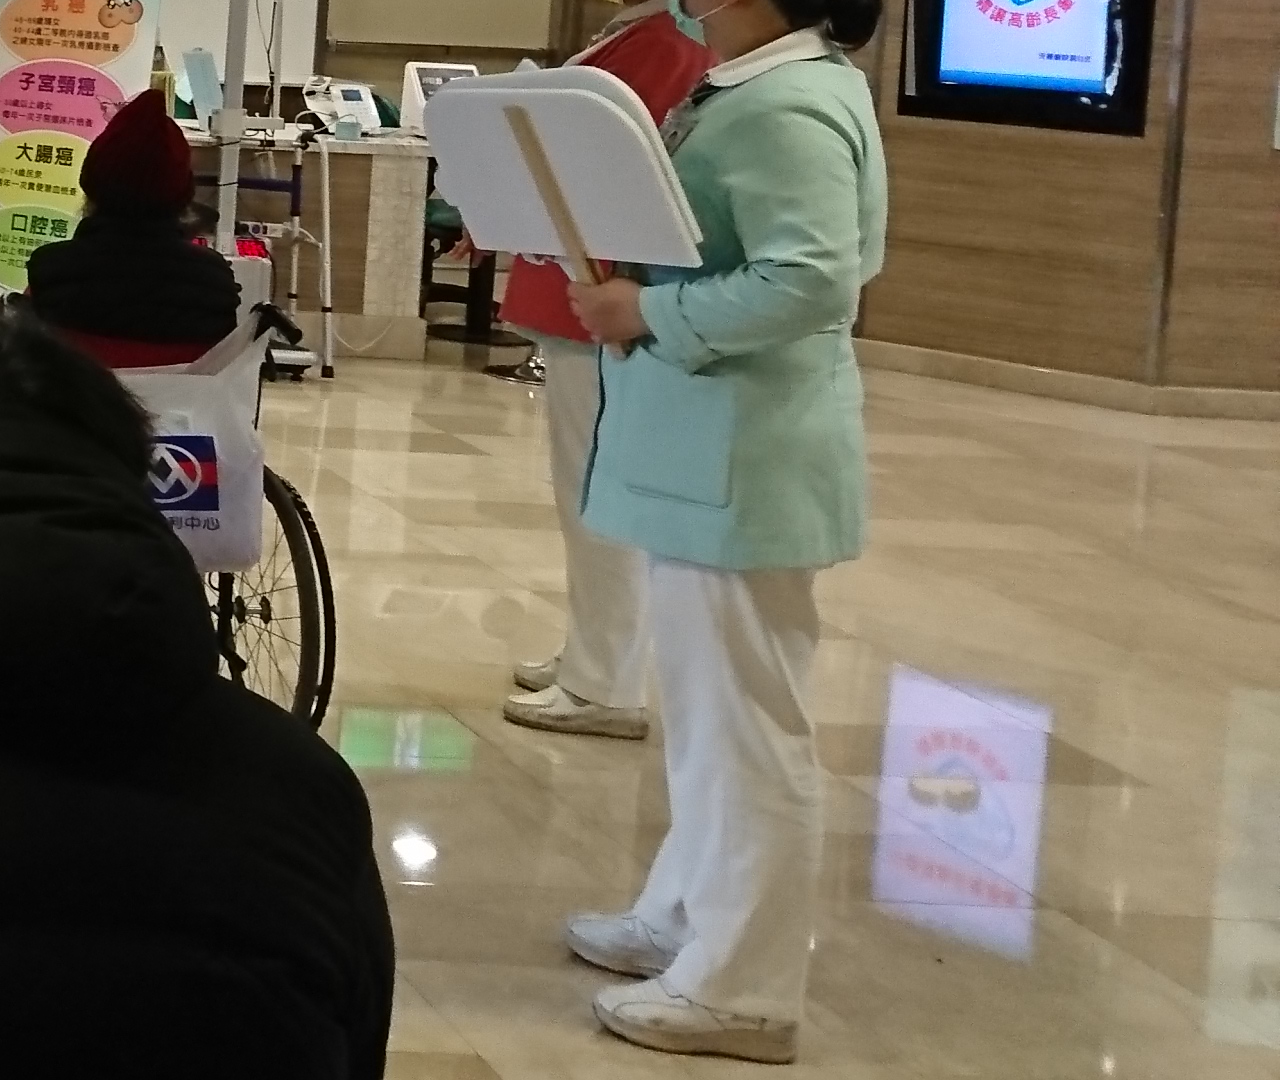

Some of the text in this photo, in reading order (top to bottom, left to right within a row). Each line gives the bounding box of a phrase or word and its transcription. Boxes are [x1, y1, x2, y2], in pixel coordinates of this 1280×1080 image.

[19, 72, 97, 97] 子宮頸癌
[15, 142, 74, 167] 大腸癌
[11, 213, 69, 239] 口腔癌
